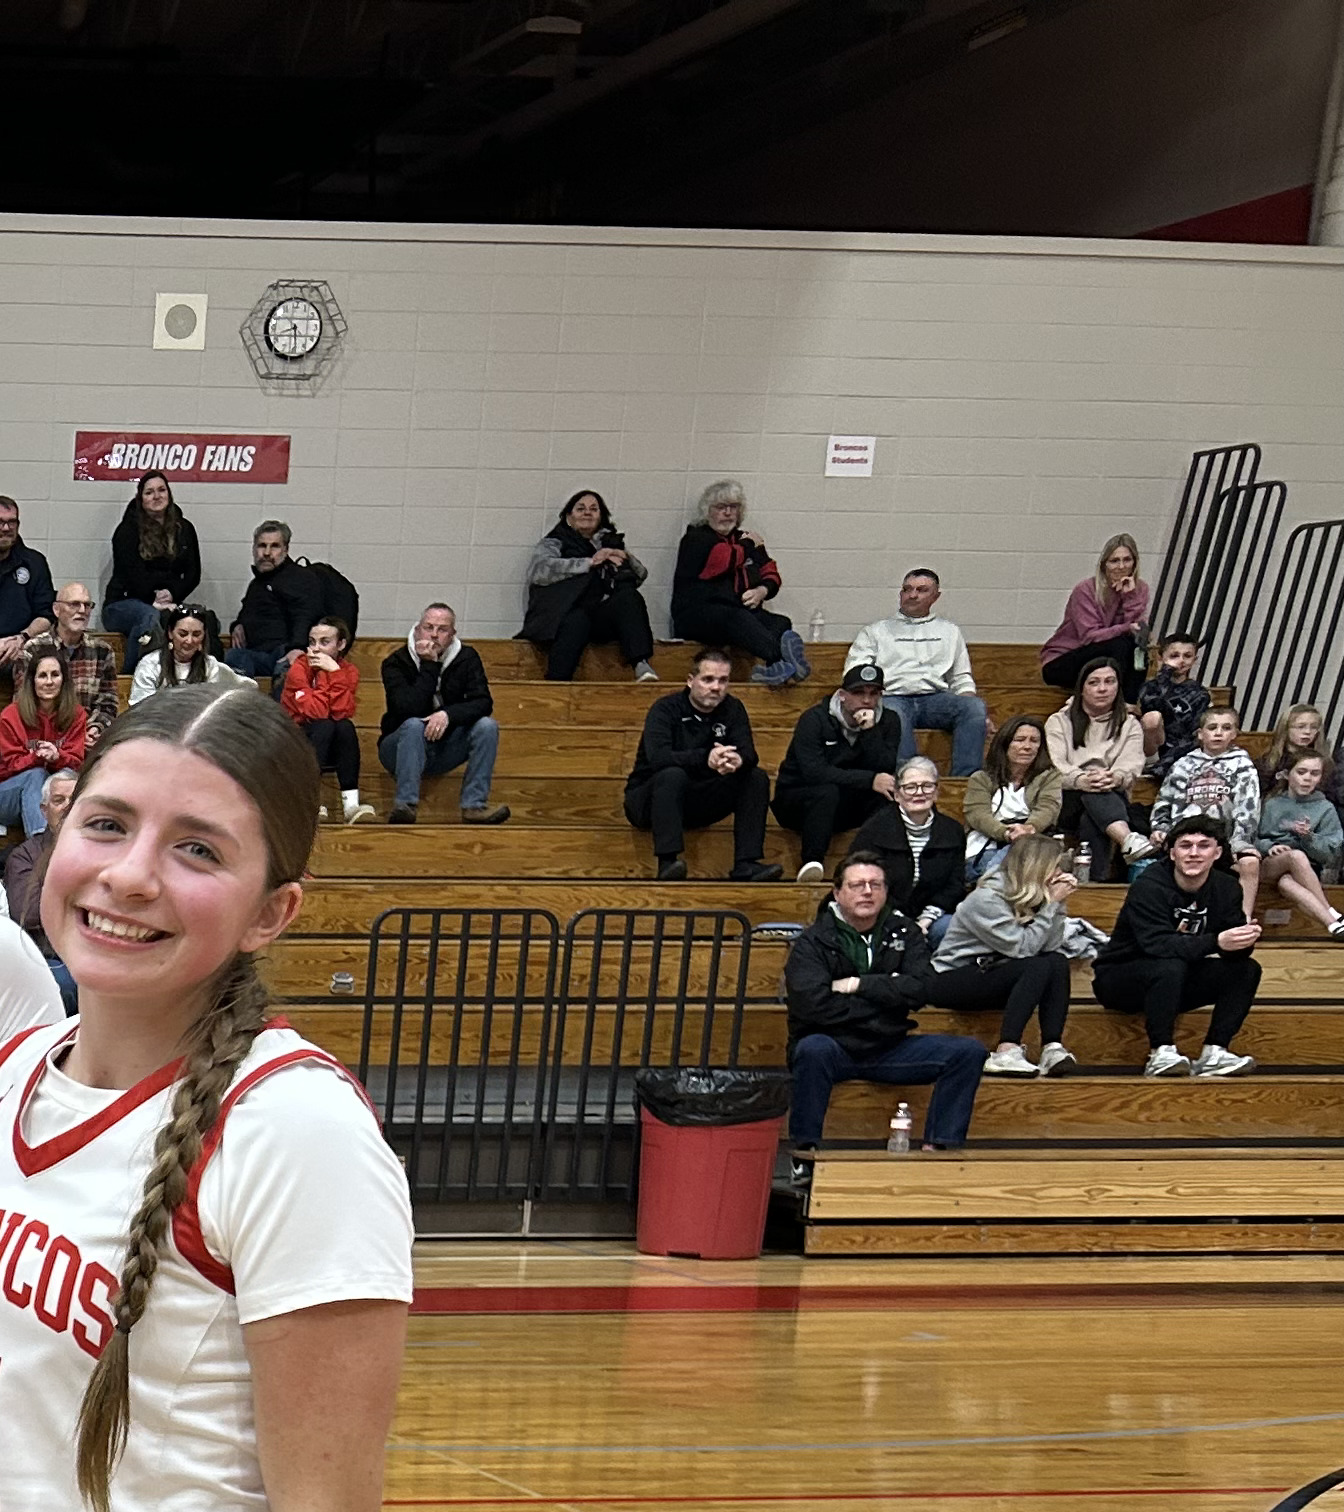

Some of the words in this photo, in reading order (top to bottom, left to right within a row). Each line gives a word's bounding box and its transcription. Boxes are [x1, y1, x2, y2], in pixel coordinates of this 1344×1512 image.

[107, 443, 197, 471] BRONCO
[201, 445, 256, 472] FANS
[831, 456, 868, 464] Students
